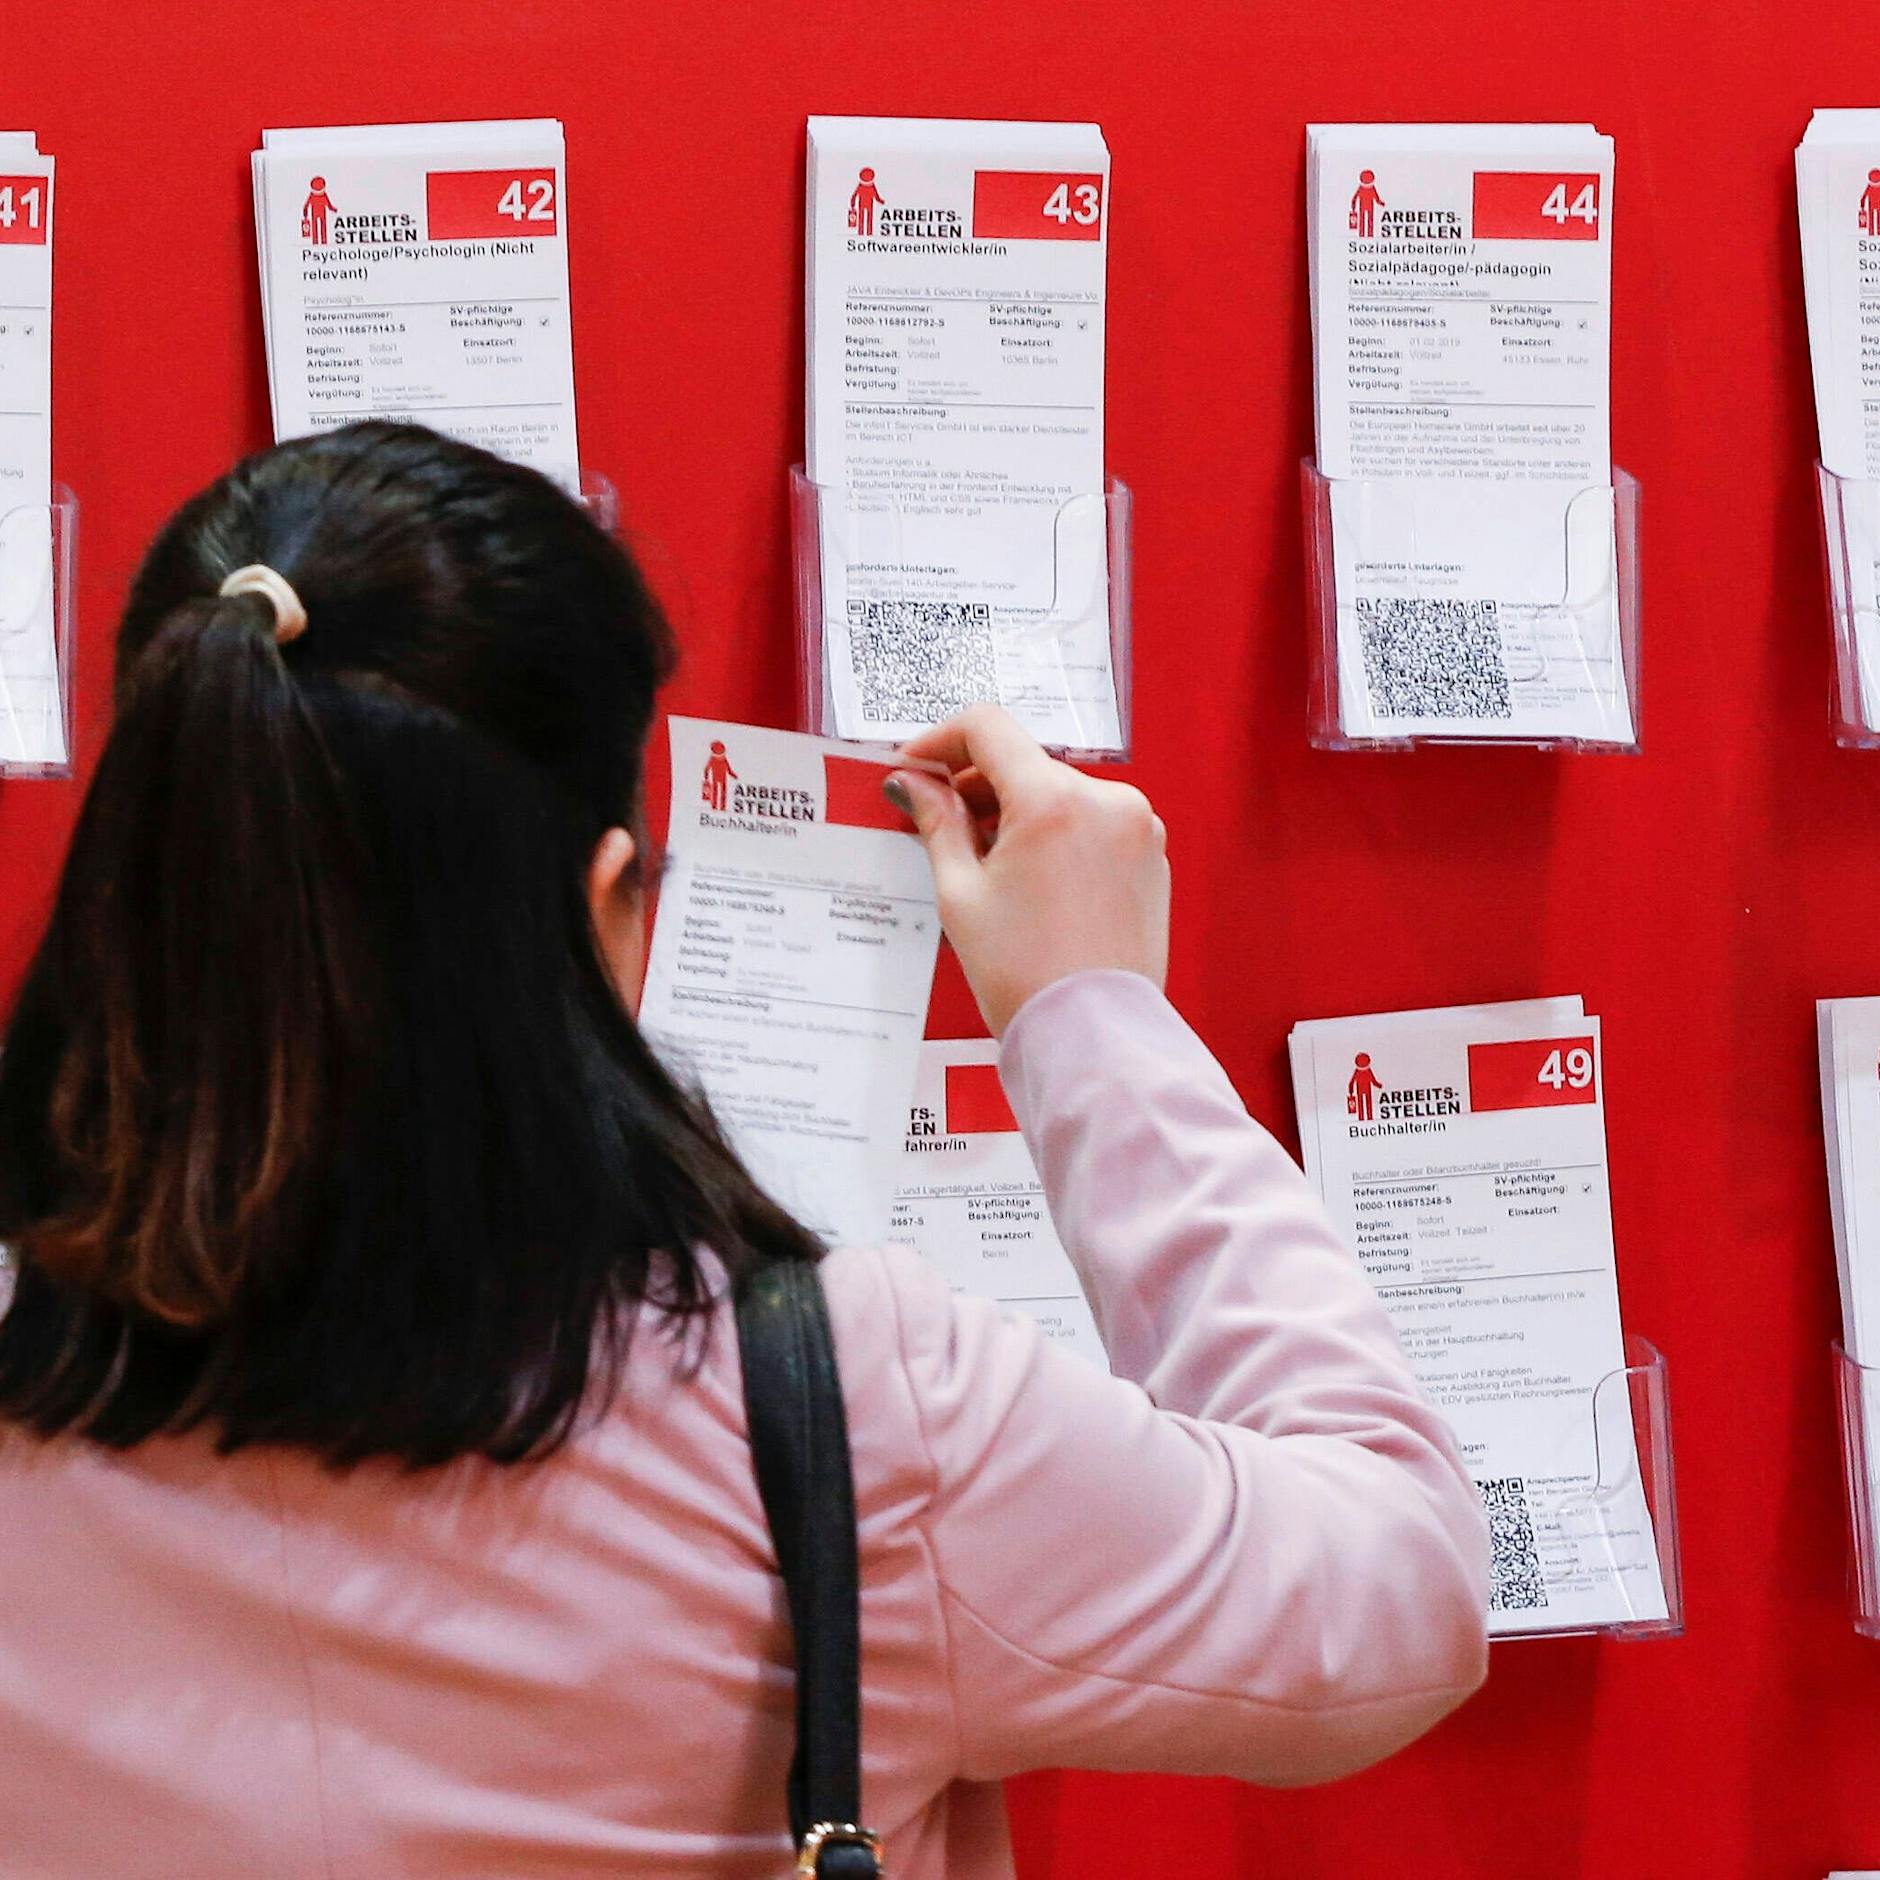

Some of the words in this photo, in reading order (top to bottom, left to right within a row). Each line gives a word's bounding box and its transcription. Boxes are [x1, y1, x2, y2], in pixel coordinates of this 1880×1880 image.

[496, 179, 554, 222] 42
[1042, 182, 1099, 226] 43
[1540, 182, 1597, 225] 44
[0, 186, 39, 229] 41
[334, 214, 416, 229] ARBEITS-
[880, 208, 962, 223] ARBEITS-
[1381, 211, 1462, 224] ARBEITS-
[335, 229, 417, 244] STELLEN
[880, 223, 962, 238] STELLEN
[1382, 225, 1462, 239] STELLEN
[302, 244, 485, 262] Psychologe/Psychologin
[490, 242, 535, 258] (Nicht
[847, 240, 1007, 256] Softwareentwickler/in
[1348, 242, 1466, 255] Sozialarbeiter/in
[304, 267, 368, 282] relevant)
[1348, 260, 1552, 278] Sozialpädagoge/-pädagogin
[450, 305, 513, 316] SV-pflichtige
[990, 305, 1052, 316] SV-pflichtige
[1490, 304, 1552, 315] SV-pflichtige
[846, 336, 883, 346] Beginn:
[1348, 337, 1386, 348] Beginn:
[846, 349, 900, 359] Arbeitszeit:
[1348, 350, 1403, 360] Arbeitszeit:
[307, 358, 363, 368] Arbeitszeit:
[846, 378, 900, 390] Vergütung:
[1348, 380, 1403, 391] Vergütung:
[734, 783, 815, 805] ARBEITS-
[734, 798, 815, 823] STELLEN
[1536, 1048, 1592, 1090] 49
[1380, 1087, 1460, 1105] ARBEITS-
[1380, 1100, 1461, 1120] STELLEN
[1349, 1120, 1446, 1139] Buchhalter/in
[1494, 1173, 1556, 1186] SV-pflichtige
[1495, 1185, 1568, 1198] Beschäftigung:
[968, 1198, 1032, 1209] SV-pflichtige
[1508, 1206, 1560, 1217] Einsatzort:
[1356, 1220, 1394, 1231] Beginn:
[982, 1230, 1034, 1241] Einsatzort:
[1357, 1232, 1412, 1244] Arbeitszeit:
[1358, 1247, 1413, 1259] Befristung:
[1364, 1261, 1414, 1274] ergütung:
